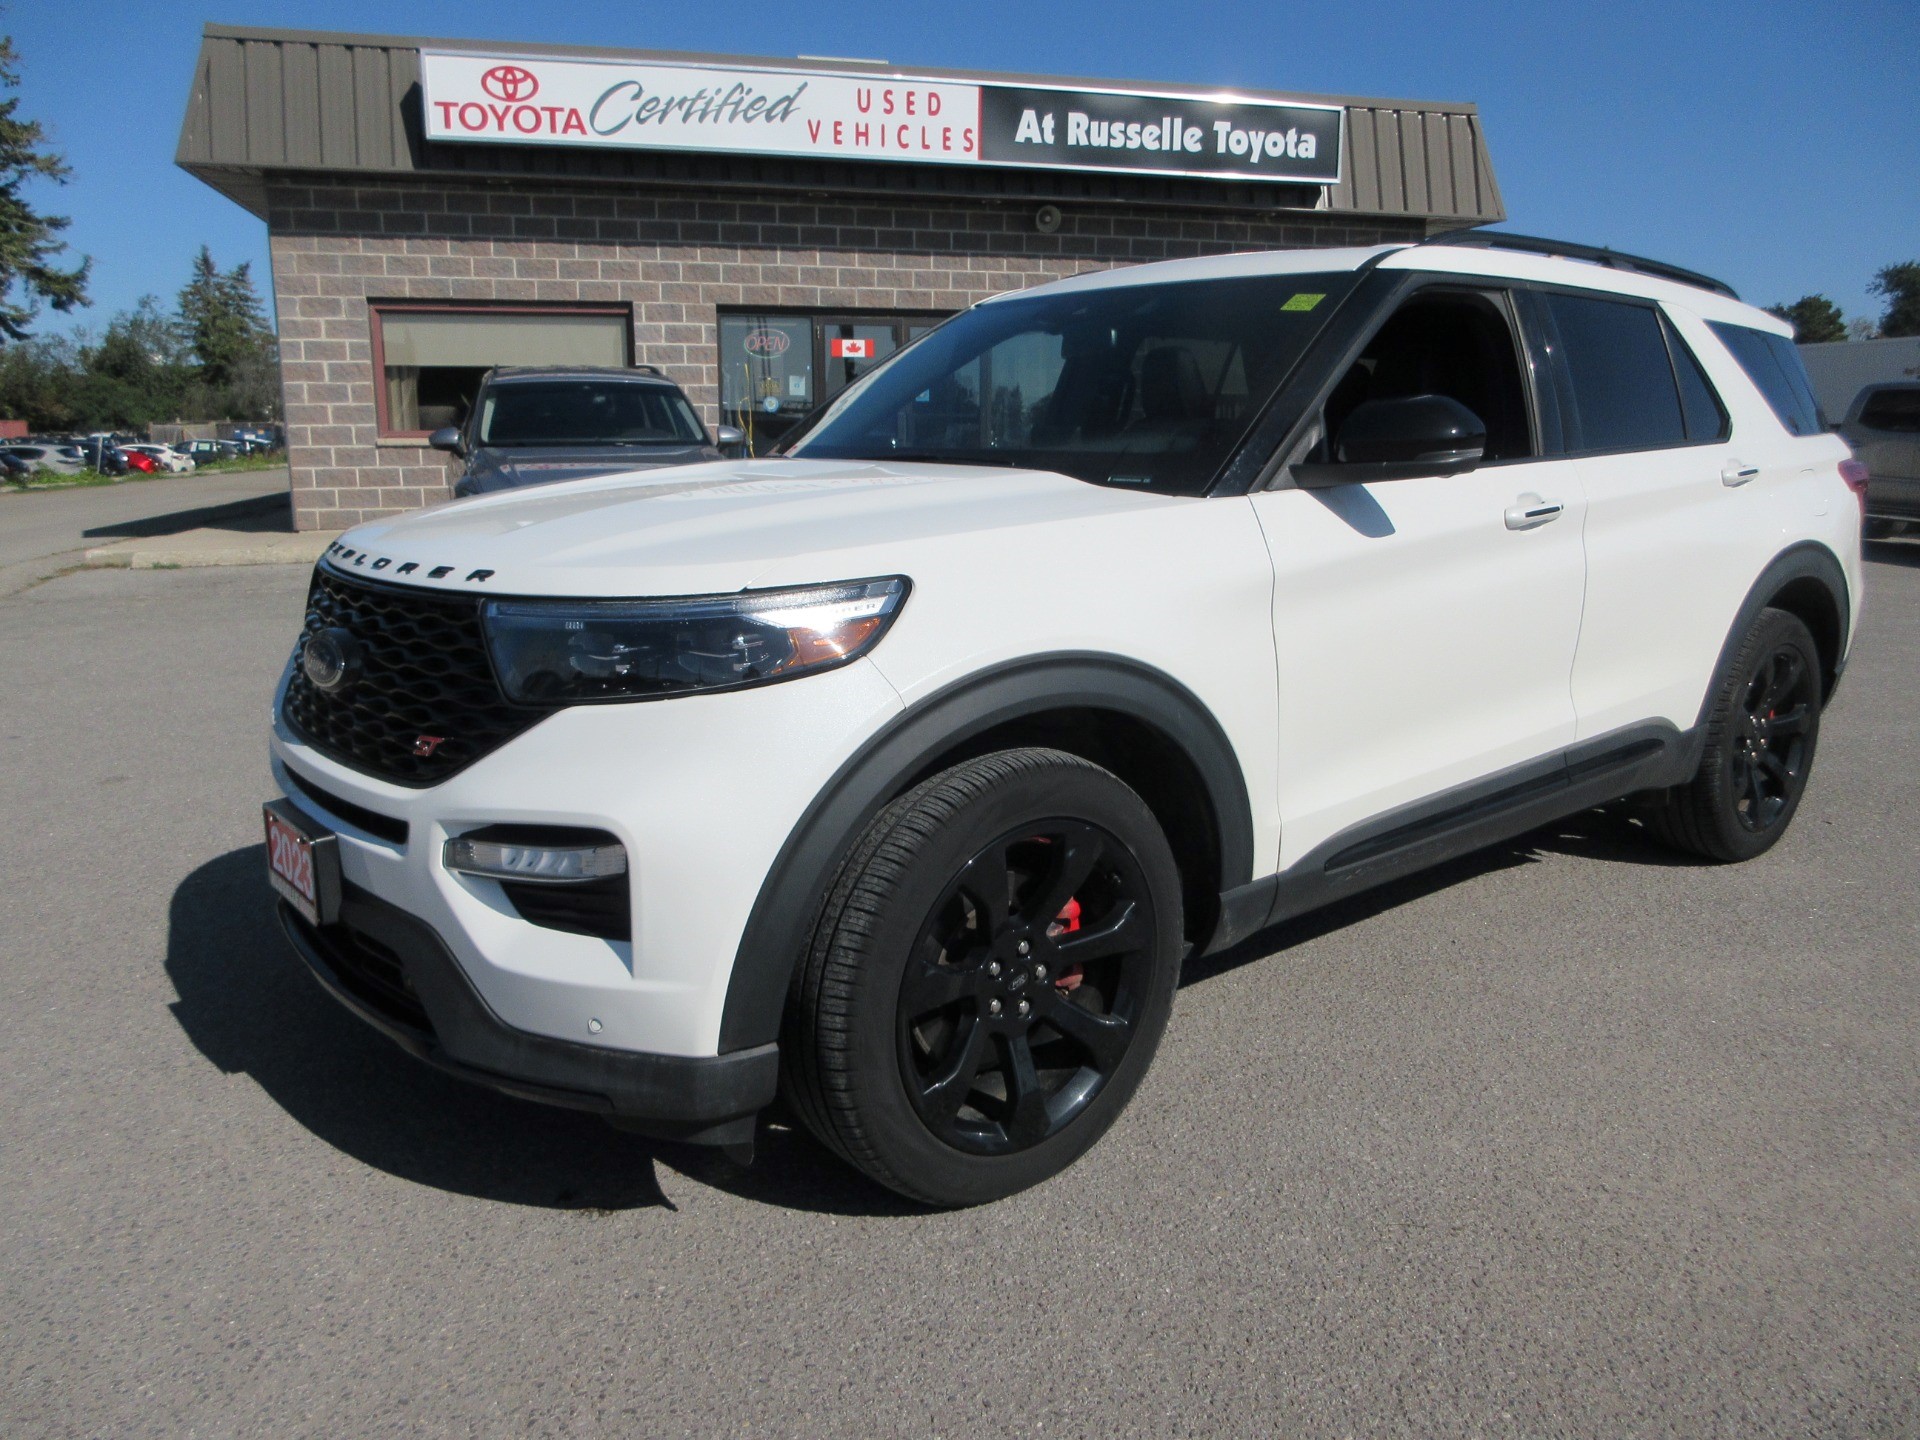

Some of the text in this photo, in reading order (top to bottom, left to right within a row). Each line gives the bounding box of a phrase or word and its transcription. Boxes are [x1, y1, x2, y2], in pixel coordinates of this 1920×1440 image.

[434, 80, 809, 137] TOYOTA Certified
[857, 88, 942, 116] USED
[807, 119, 975, 153] VEHICLES
[1015, 109, 1316, 163] At Russelle Toyota
[746, 336, 785, 351] OPEN
[270, 825, 315, 901] 2023
